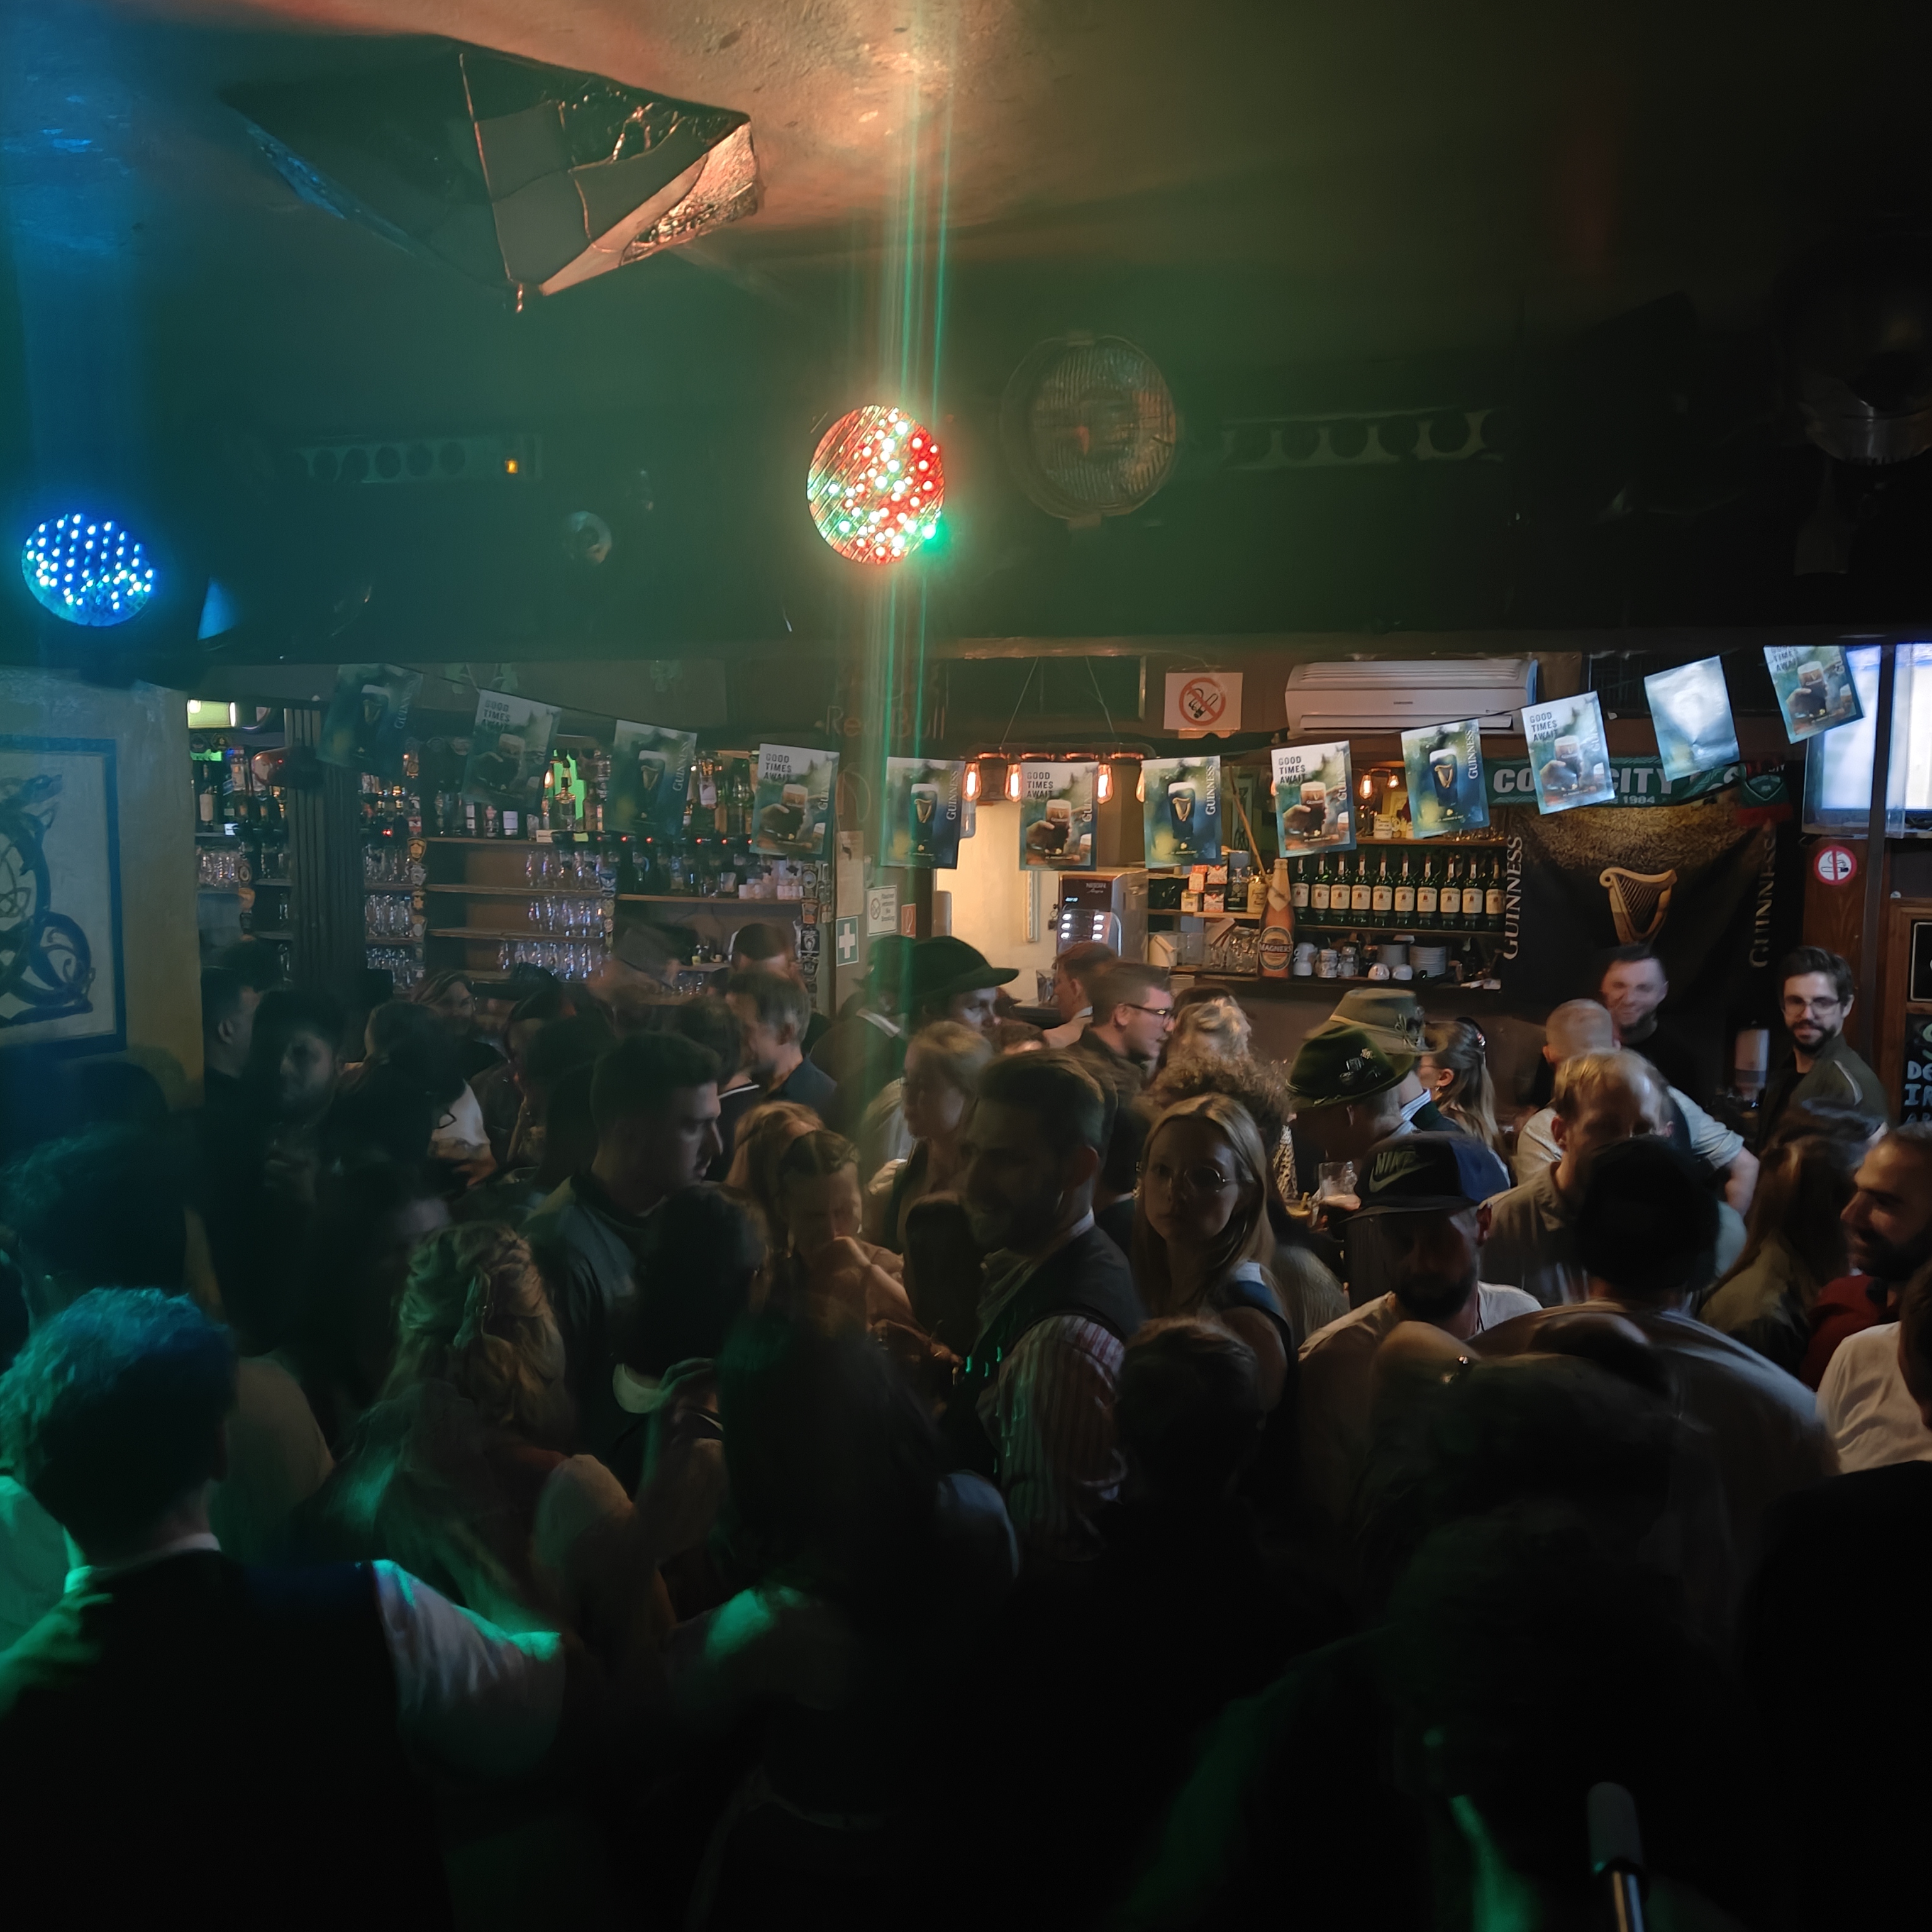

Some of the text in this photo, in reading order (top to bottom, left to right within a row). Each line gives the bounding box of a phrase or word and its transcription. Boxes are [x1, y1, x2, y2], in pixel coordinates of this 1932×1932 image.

[483, 709, 510, 722] TIMES
[1530, 711, 1552, 724] GOOD
[1531, 719, 1558, 733] TIMES
[1533, 729, 1558, 742] AWAIT
[766, 753, 789, 763] GOOD
[1465, 730, 1479, 780] GUINNESS
[1279, 756, 1302, 766] GOOD
[765, 762, 792, 773] TIMES
[1279, 765, 1306, 775] TIMES
[1026, 772, 1050, 780] GOOD
[1280, 774, 1306, 784] AWAIT
[1026, 780, 1053, 789] TIMES
[946, 770, 958, 820] GUINNESS
[1026, 790, 1053, 799] AWAIT
[1206, 765, 1217, 816] GUINNESS
[1623, 795, 1655, 804] 1984
[1503, 835, 1522, 960] GUINNESS
